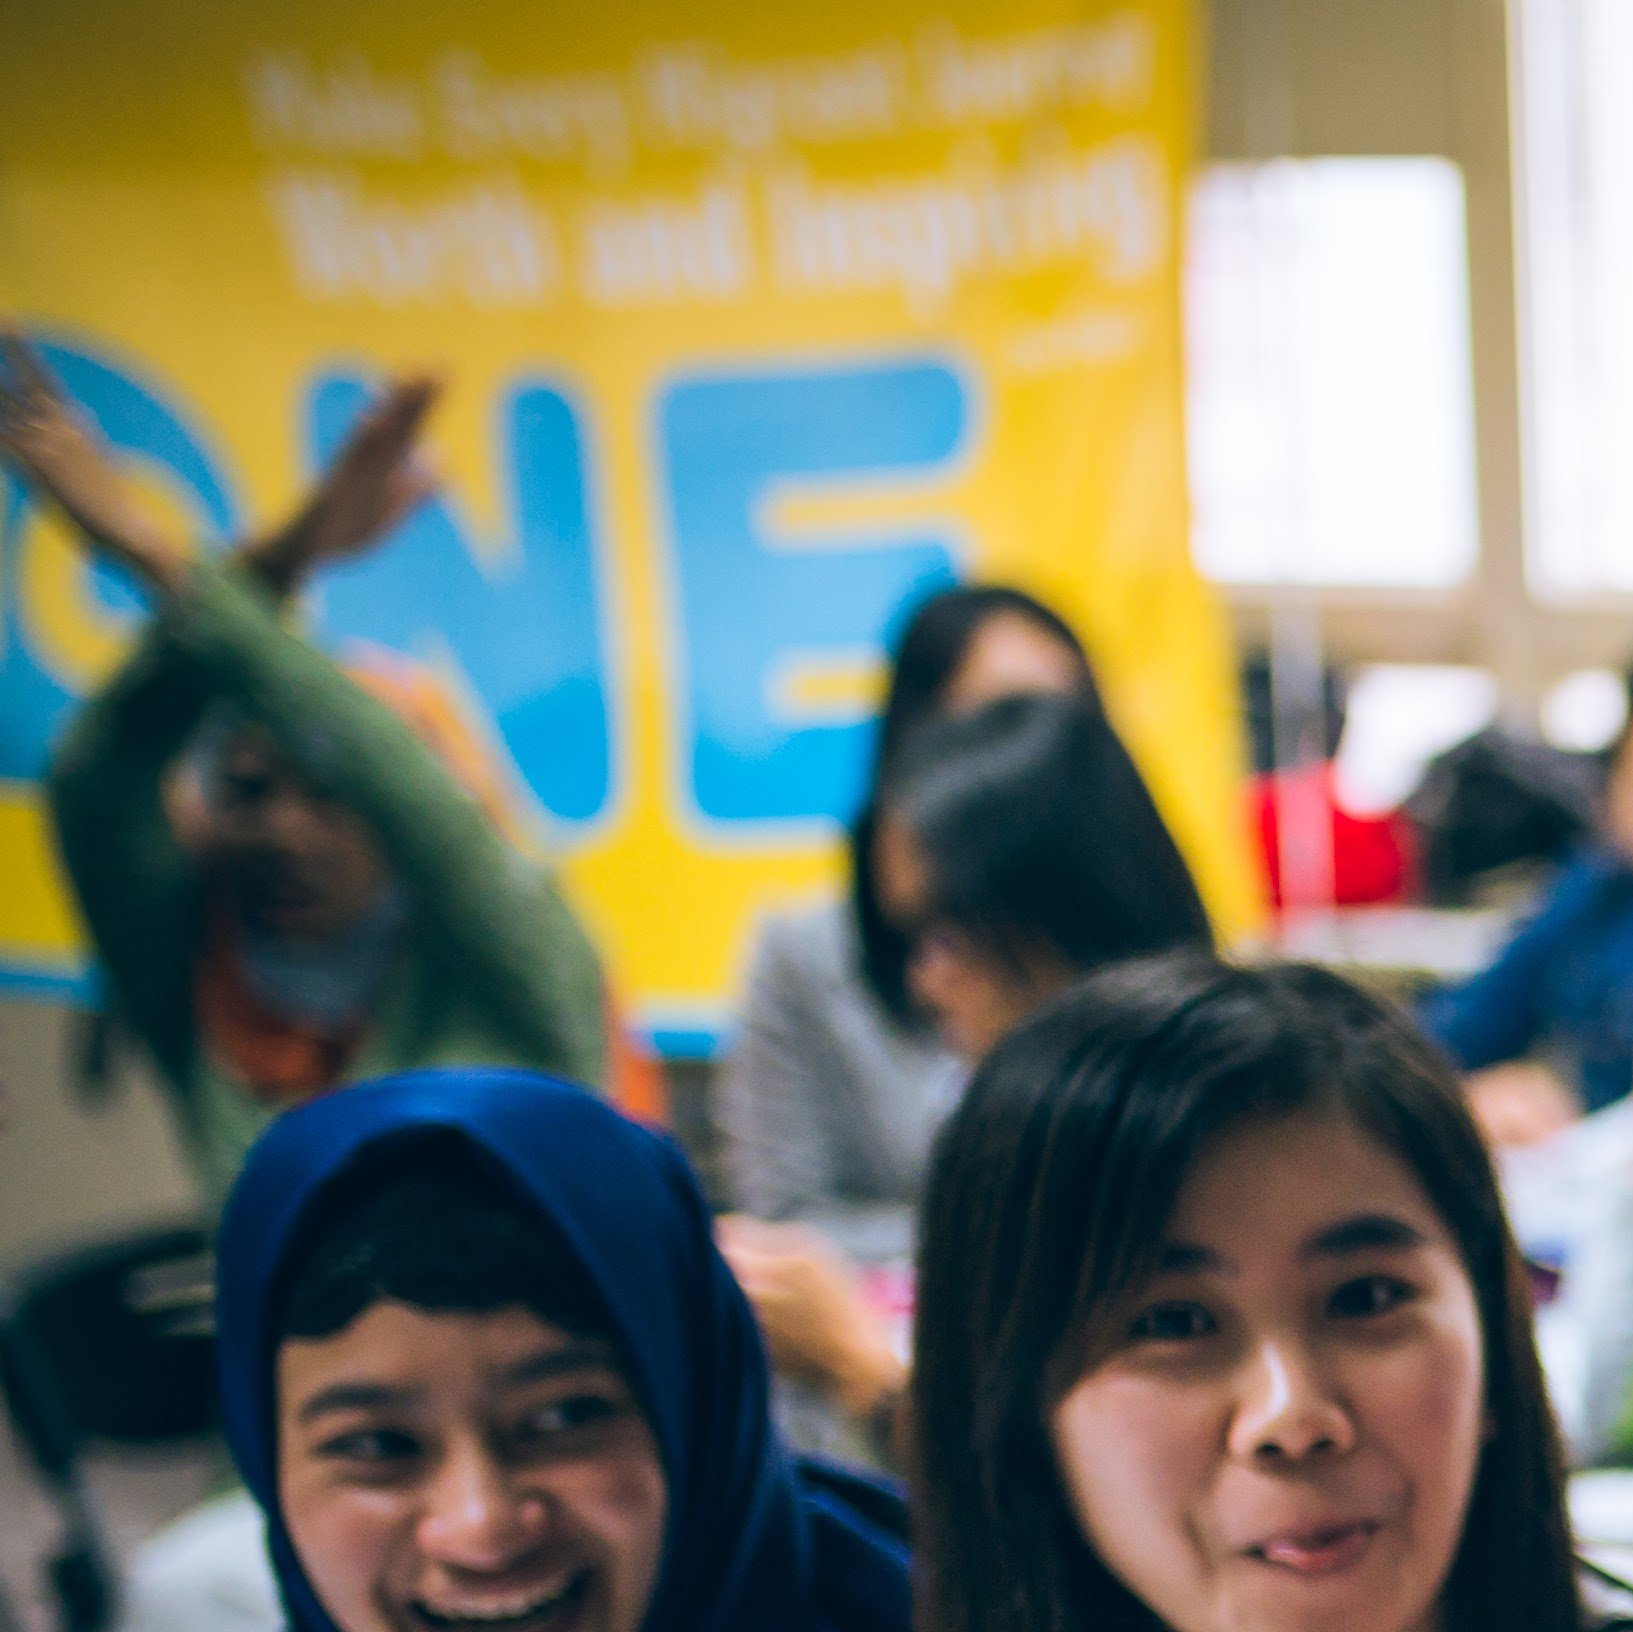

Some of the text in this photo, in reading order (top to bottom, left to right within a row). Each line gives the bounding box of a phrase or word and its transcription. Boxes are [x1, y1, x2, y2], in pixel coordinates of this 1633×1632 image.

[266, 124, 1164, 322] Worth and Inspiring
